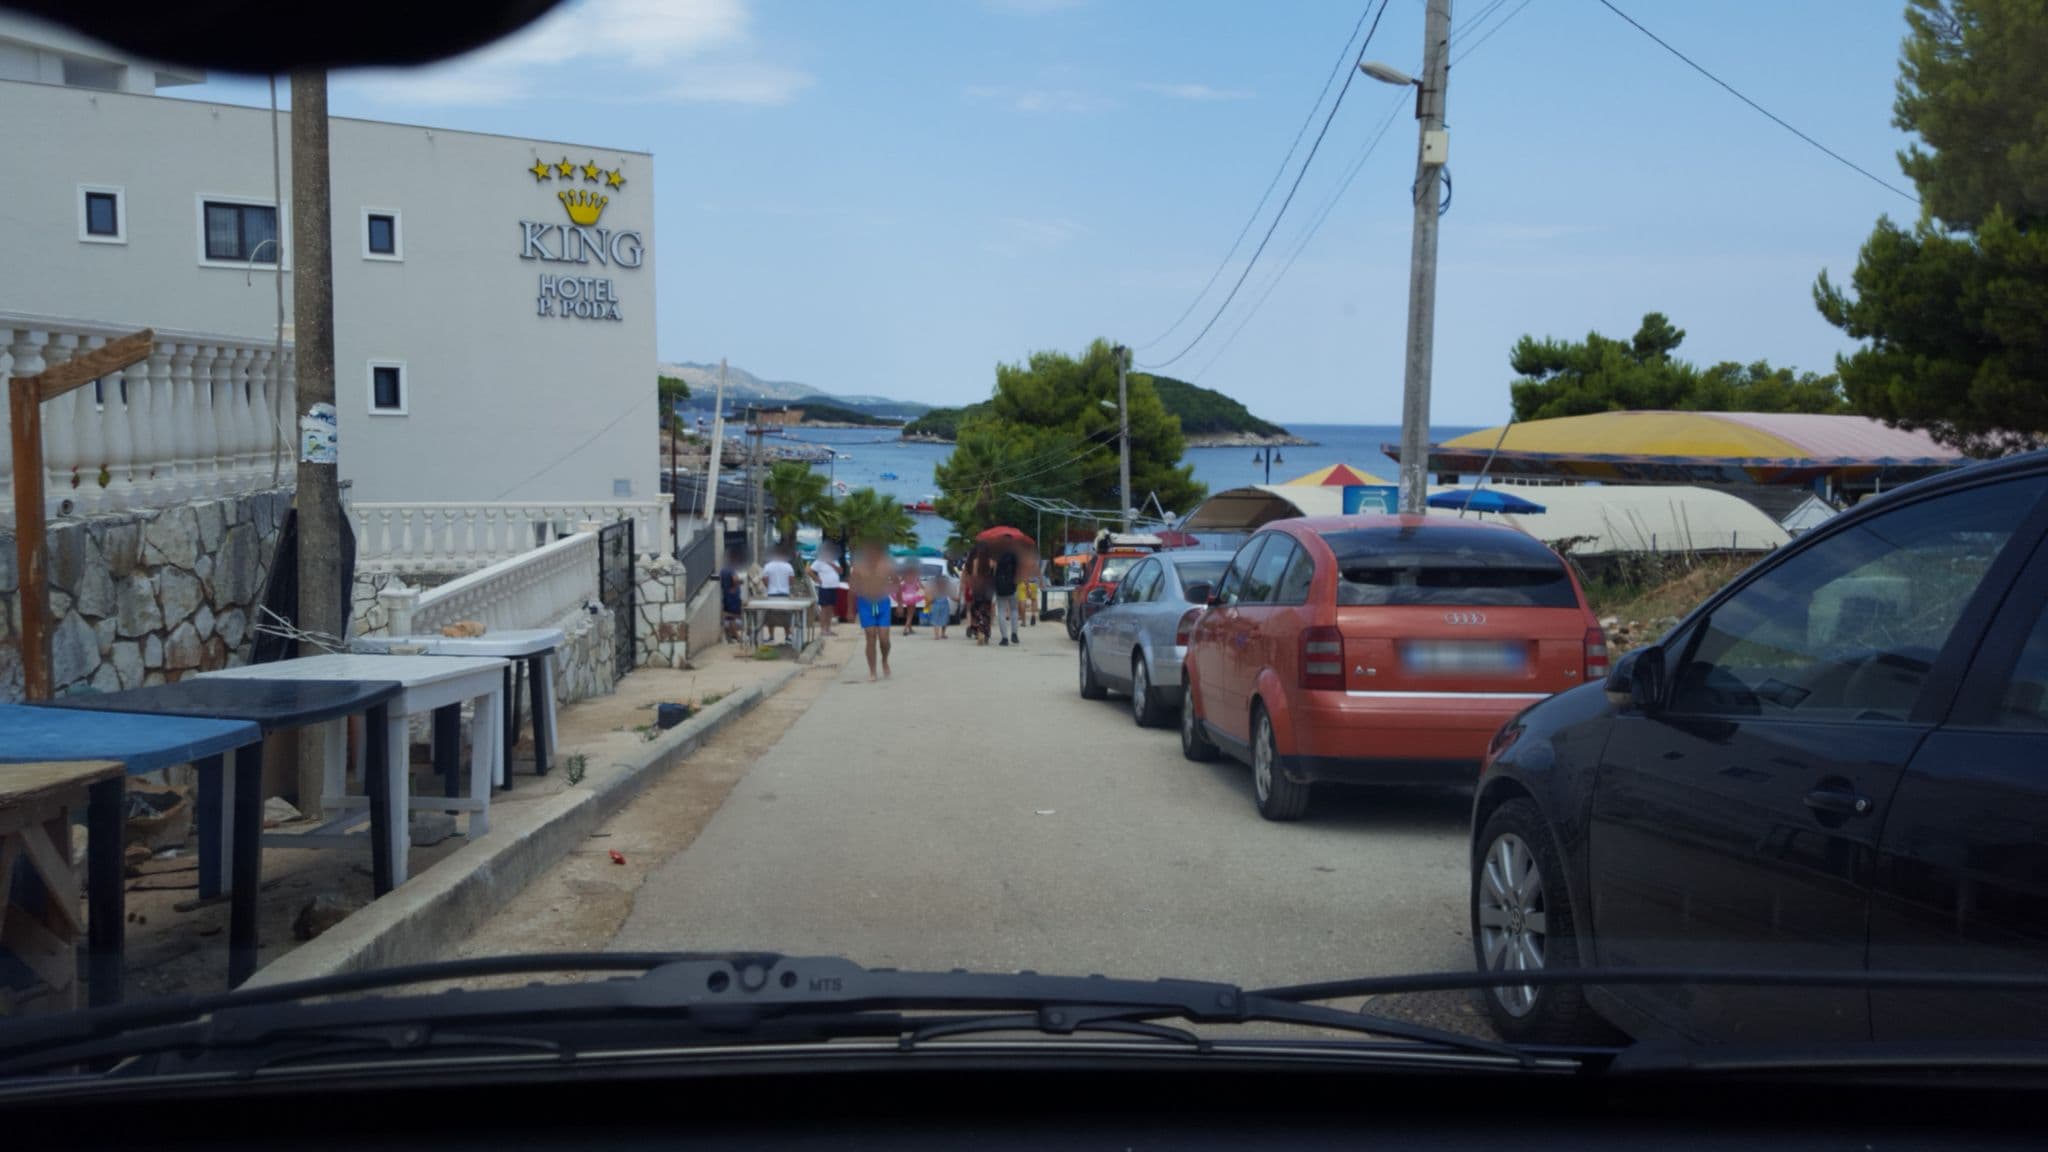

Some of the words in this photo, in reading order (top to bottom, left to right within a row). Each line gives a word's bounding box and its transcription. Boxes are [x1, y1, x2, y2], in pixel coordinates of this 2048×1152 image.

[519, 220, 645, 269] KING
[539, 273, 618, 302] HOTEL
[537, 297, 554, 317] P.
[560, 299, 623, 321] PODA
